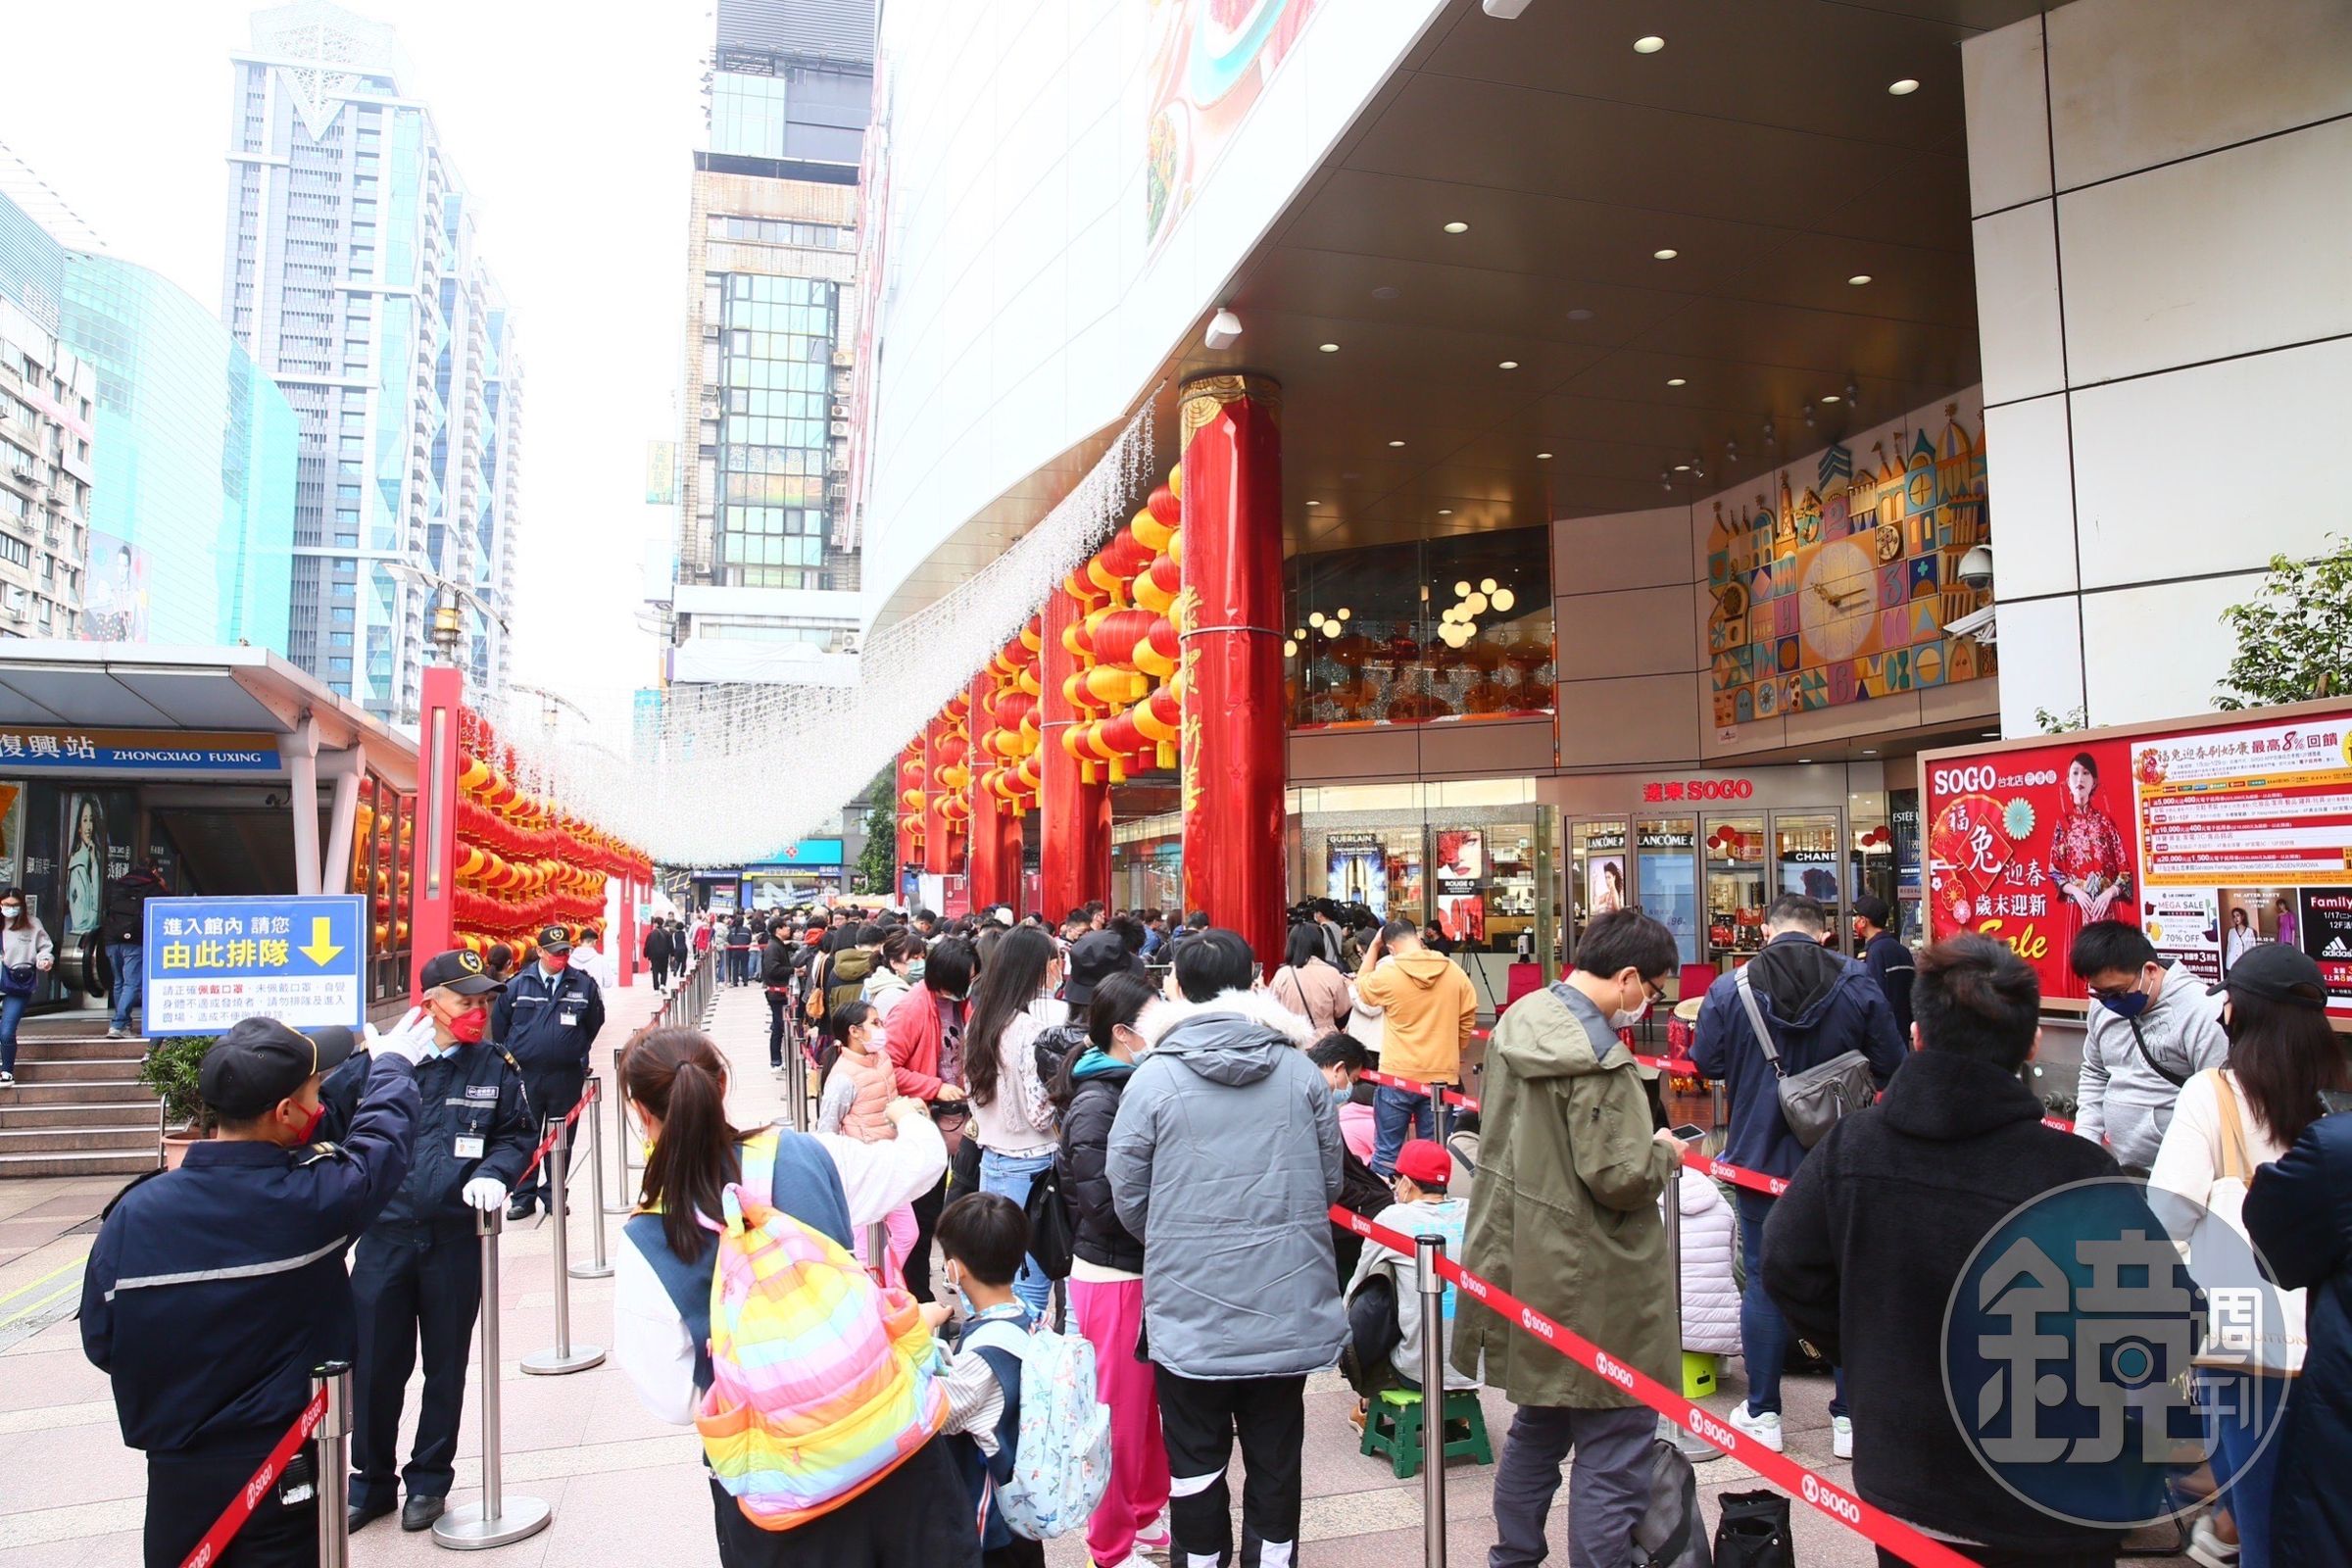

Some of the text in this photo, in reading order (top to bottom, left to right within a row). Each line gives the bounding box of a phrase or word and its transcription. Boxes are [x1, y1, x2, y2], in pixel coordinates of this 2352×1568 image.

[0, 733, 262, 762] 復興站 ZHONGXIAO FUXING
[1643, 778, 1753, 803] 遠東 SOGO
[1935, 765, 1996, 796] SOGO
[1892, 810, 1915, 822] ESTÉE
[1588, 836, 1618, 848] LANCÔME
[1638, 834, 1688, 846] LANCÔME
[1948, 805, 2046, 887] 福 兔 迎春
[1795, 853, 1838, 861] CHANE
[1975, 894, 2046, 916] 歲末迎新
[164, 915, 290, 936] 進入館內 請您
[163, 939, 290, 970] 由此排隊
[2048, 1120, 2066, 1131] SOGO
[1717, 1166, 1737, 1179] SOGO
[1468, 1277, 1487, 1298] SOGO
[1531, 1314, 1553, 1340] SOGO
[1607, 1360, 1634, 1389] SOGO
[308, 1398, 322, 1427] SOGO
[1704, 1419, 1736, 1450] SOGO
[255, 1463, 272, 1496] SOGO
[1820, 1491, 1860, 1524] SOGO
